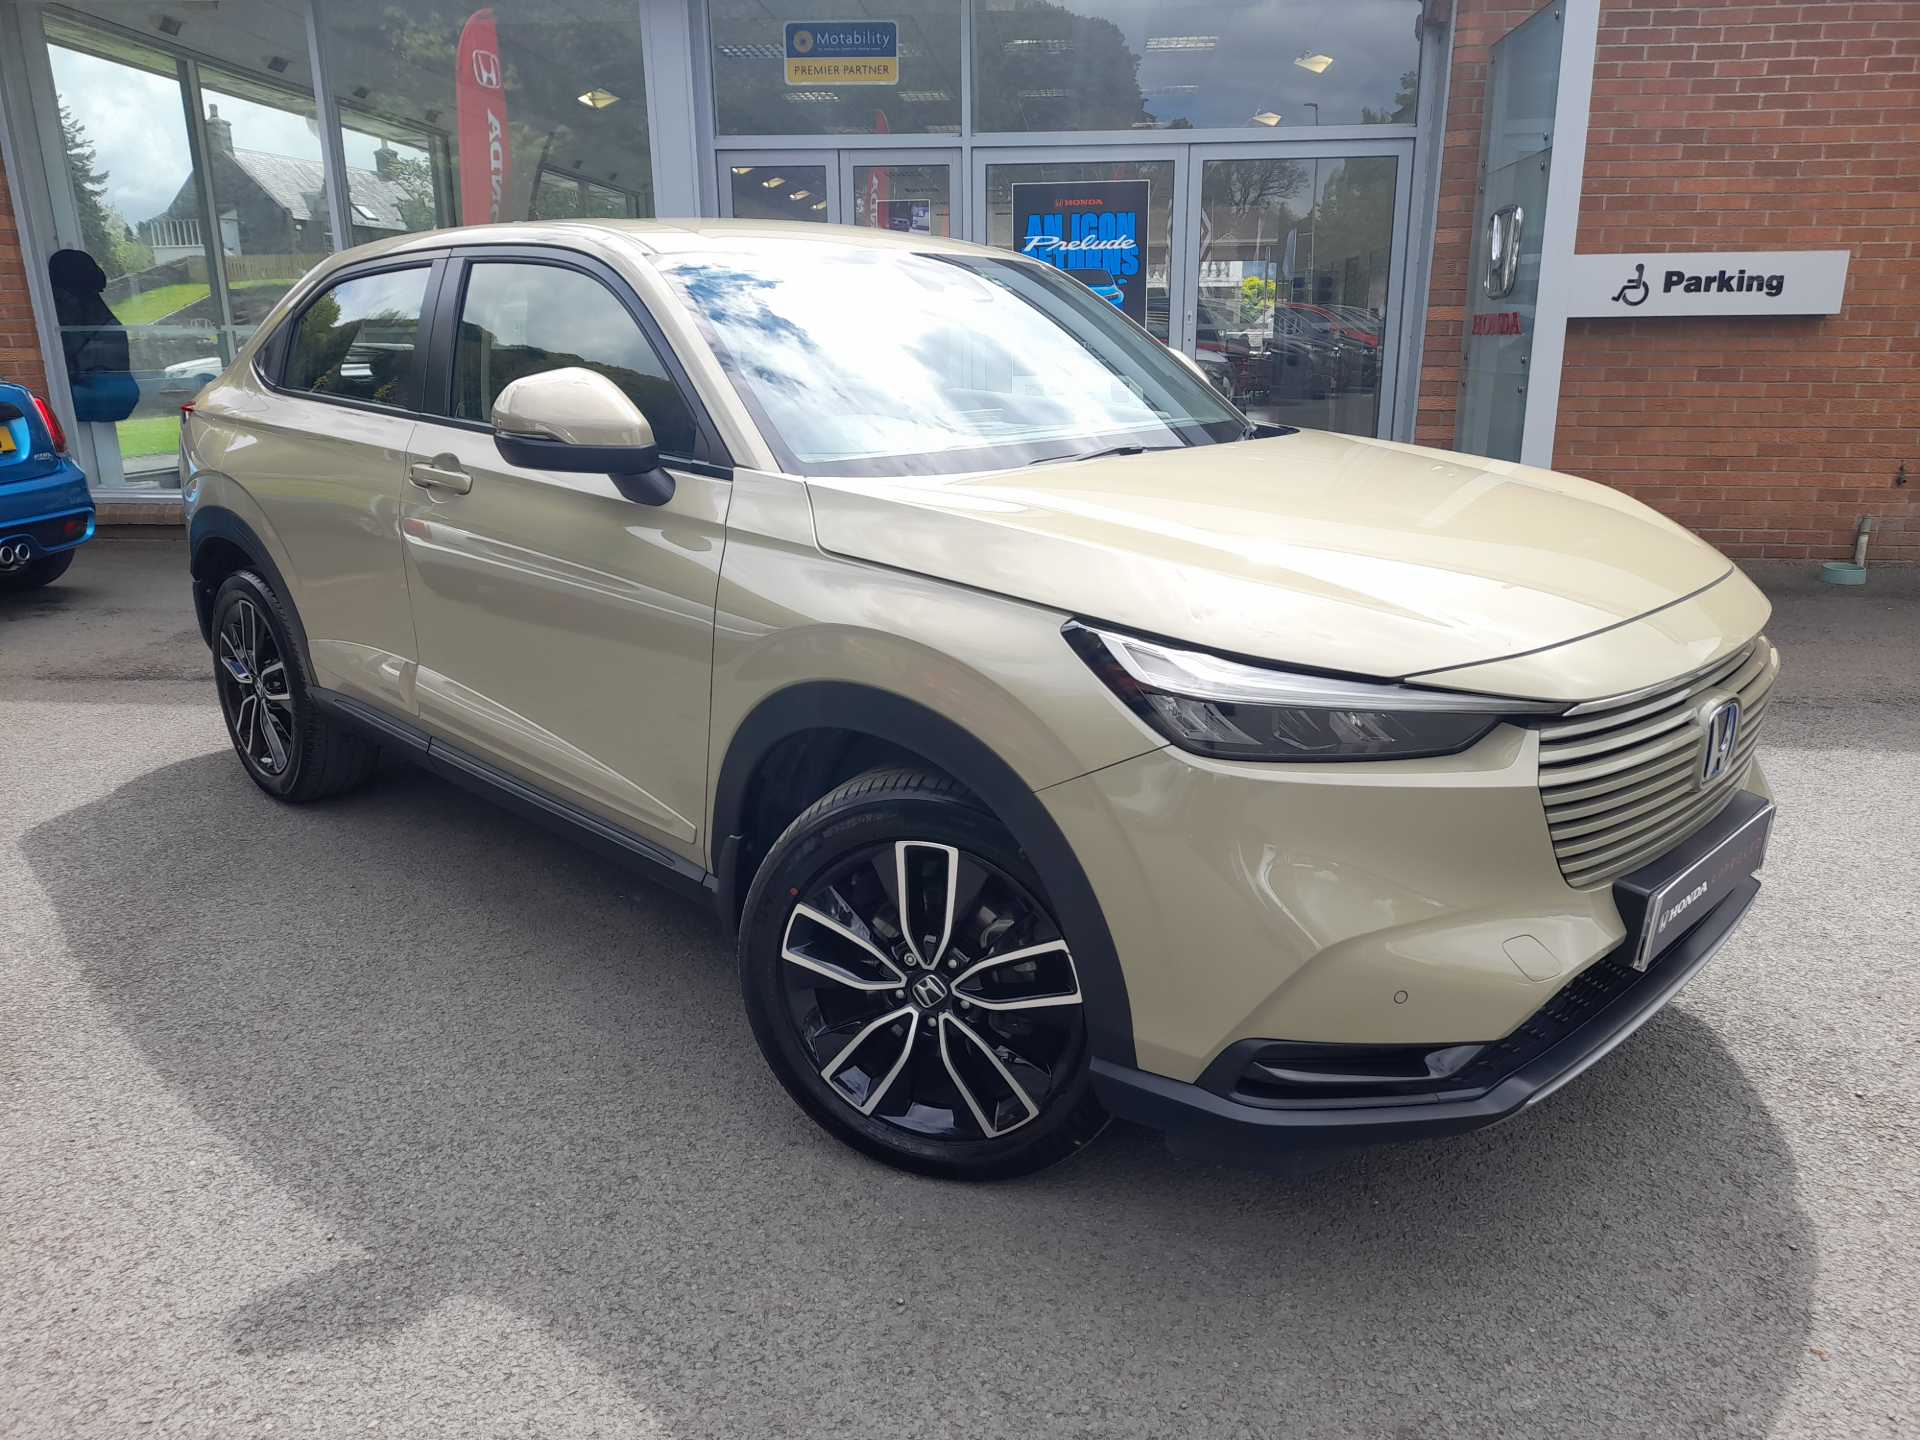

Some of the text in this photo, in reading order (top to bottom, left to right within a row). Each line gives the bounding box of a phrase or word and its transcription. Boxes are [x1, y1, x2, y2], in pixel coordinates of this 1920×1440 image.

[816, 30, 890, 48] Motability
[794, 64, 889, 75] PREMIER PARTNER
[1064, 199, 1105, 207] HONDA
[1071, 211, 1137, 243] ICON
[1023, 234, 1137, 252] Prelude
[1663, 269, 1785, 297] Parking
[1668, 880, 1709, 922] HONDA
